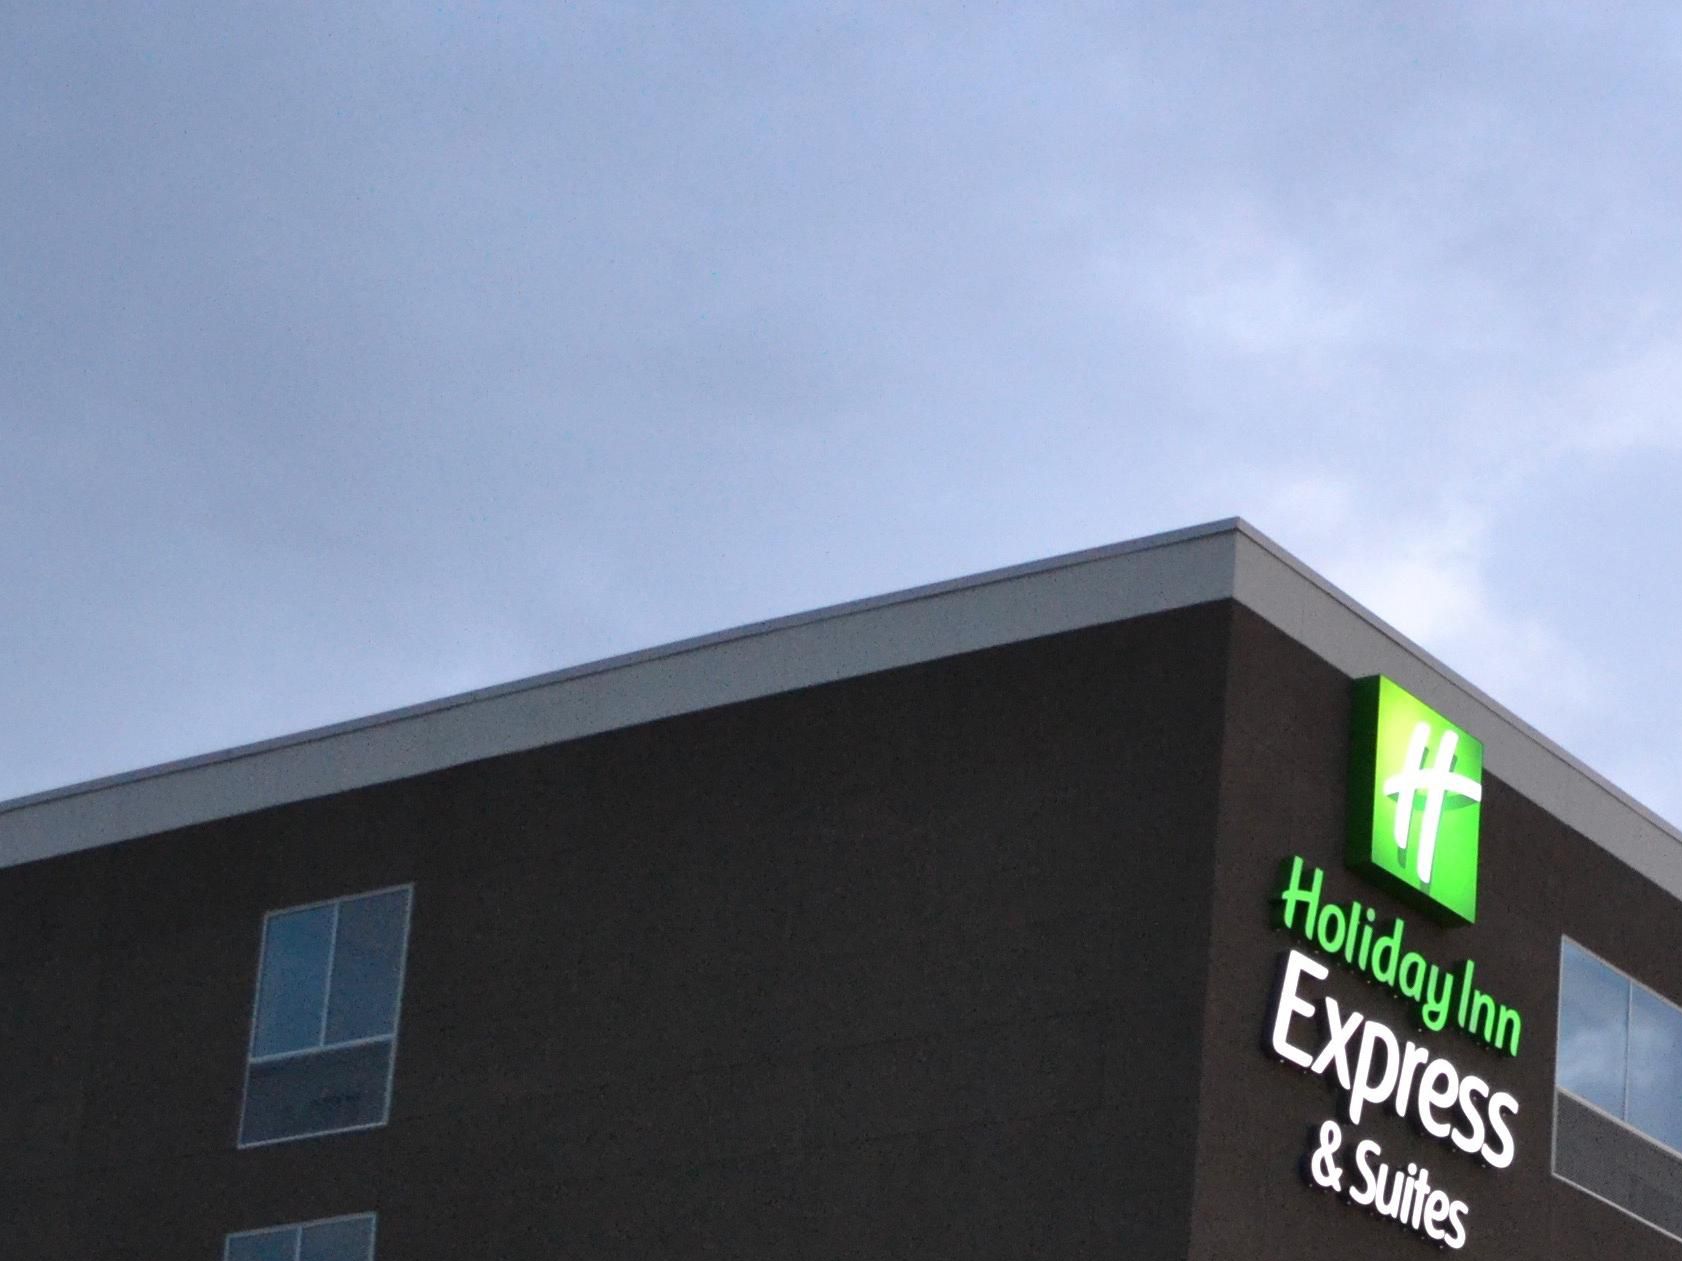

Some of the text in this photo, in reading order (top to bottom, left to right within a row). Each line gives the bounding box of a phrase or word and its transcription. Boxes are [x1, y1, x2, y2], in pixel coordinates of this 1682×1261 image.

[1281, 855, 1522, 1057] Holiday Inn
[1271, 949, 1520, 1169] Express
[1310, 1120, 1469, 1250] & Suites
